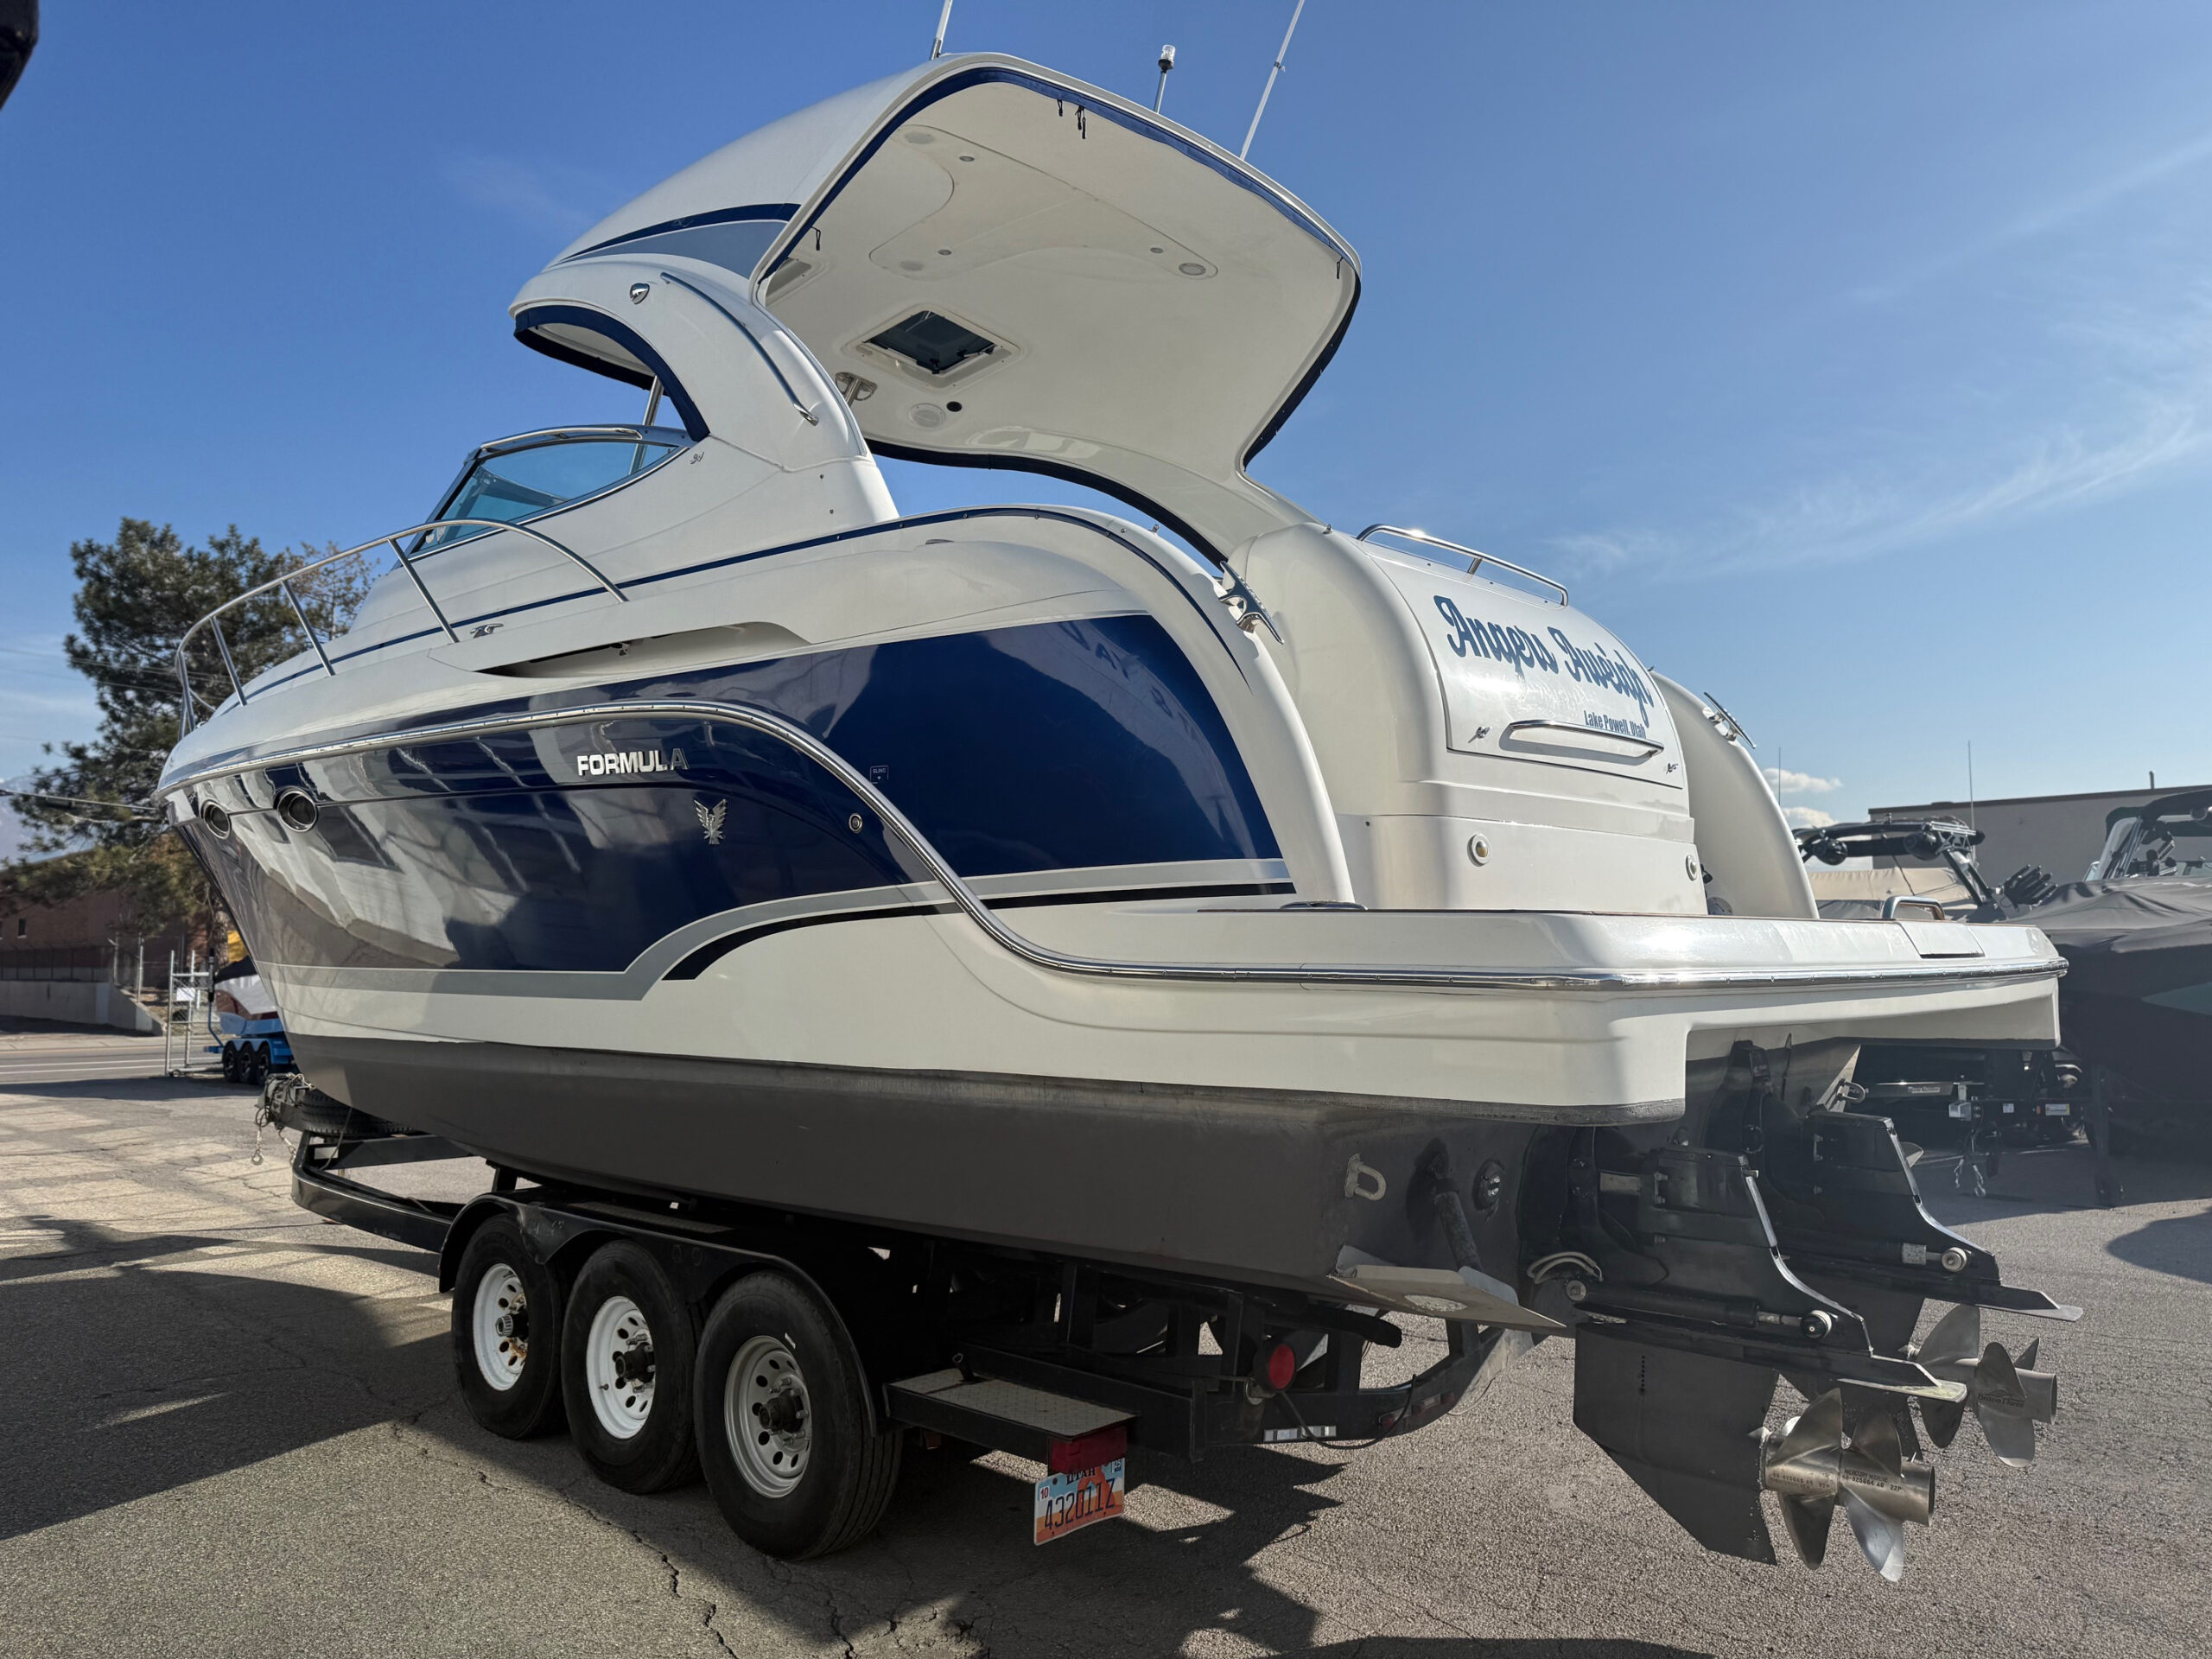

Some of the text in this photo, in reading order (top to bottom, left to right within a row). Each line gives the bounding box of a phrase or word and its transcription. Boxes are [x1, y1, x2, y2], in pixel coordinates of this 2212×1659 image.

[1547, 626, 1655, 728] Aweigh
[1583, 709, 1603, 728] Lake
[1630, 720, 1647, 740] Utah
[577, 747, 690, 776] FORMULA
[1039, 1486, 1049, 1499] 10
[1044, 1478, 1116, 1530] 432011Z
